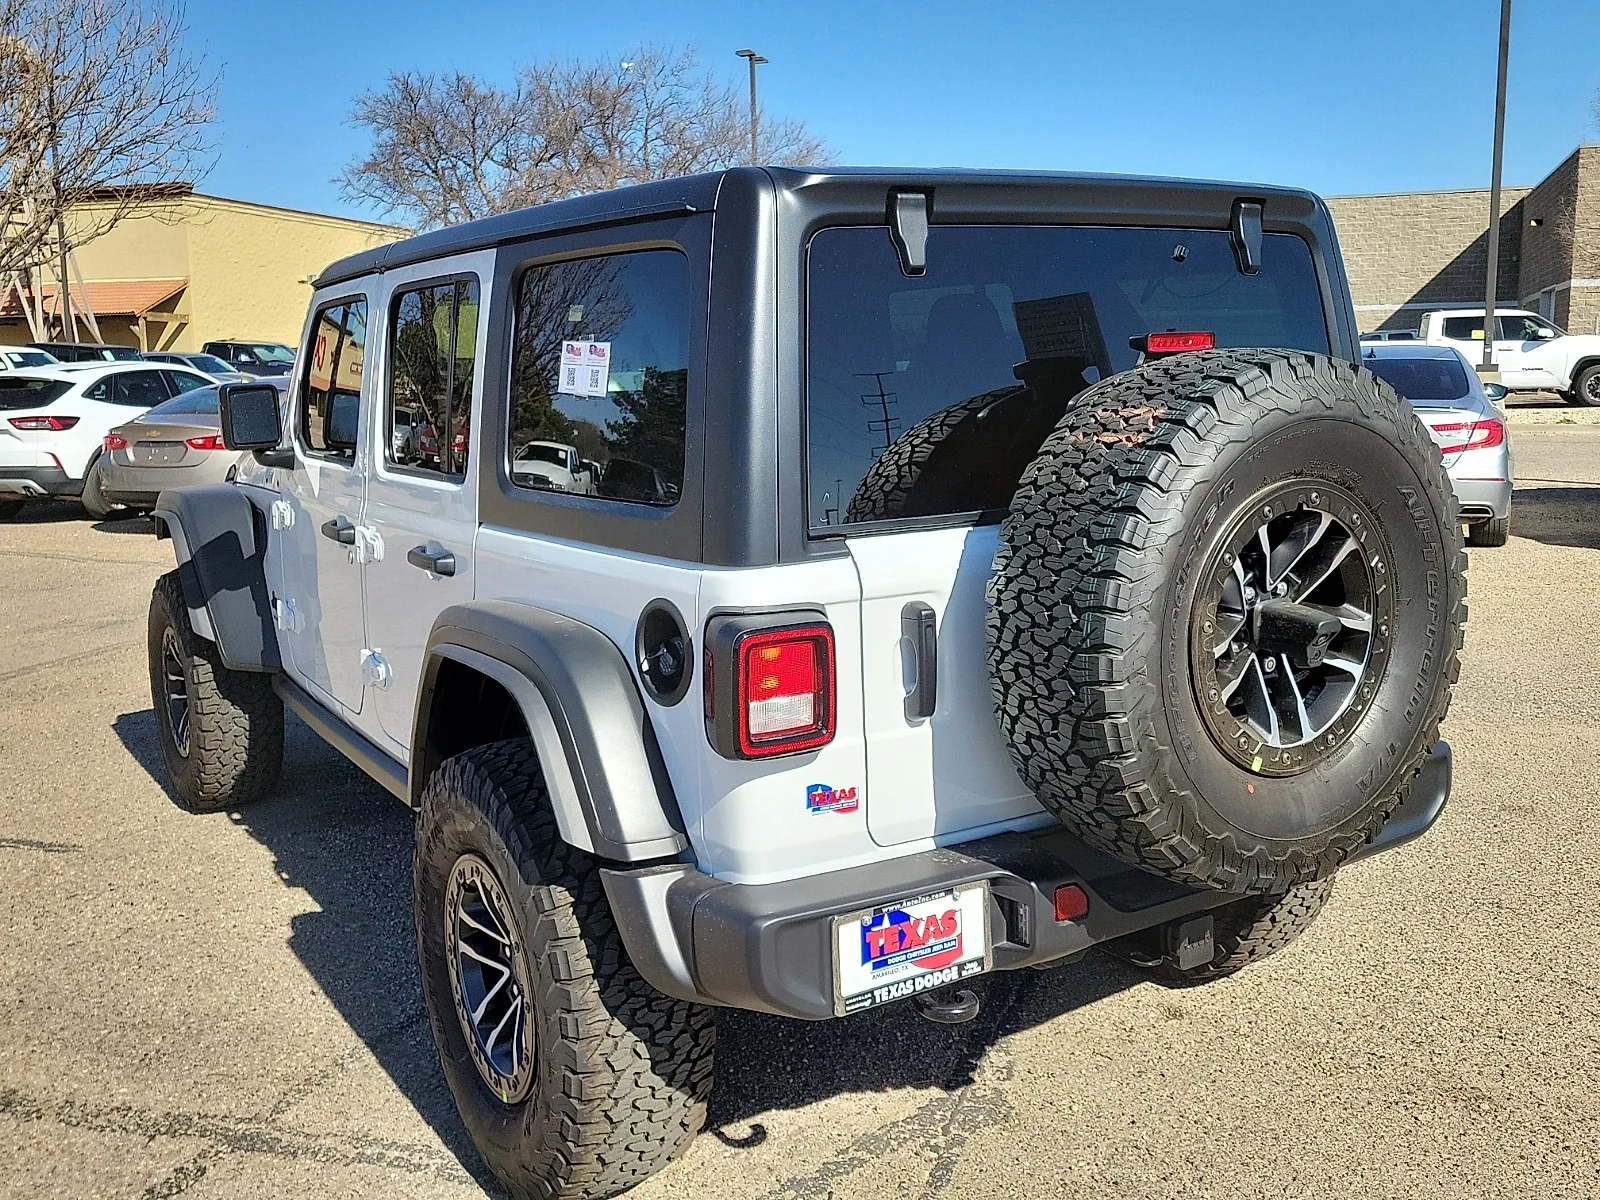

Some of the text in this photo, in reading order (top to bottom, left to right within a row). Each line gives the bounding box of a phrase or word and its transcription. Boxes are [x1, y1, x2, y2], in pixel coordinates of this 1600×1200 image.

[811, 787, 857, 806] TEXAS
[881, 892, 946, 913] www.AutoInc.com
[866, 909, 958, 958] TEXAS
[874, 979, 915, 1004] TEXAS
[915, 966, 959, 991] DODGE
